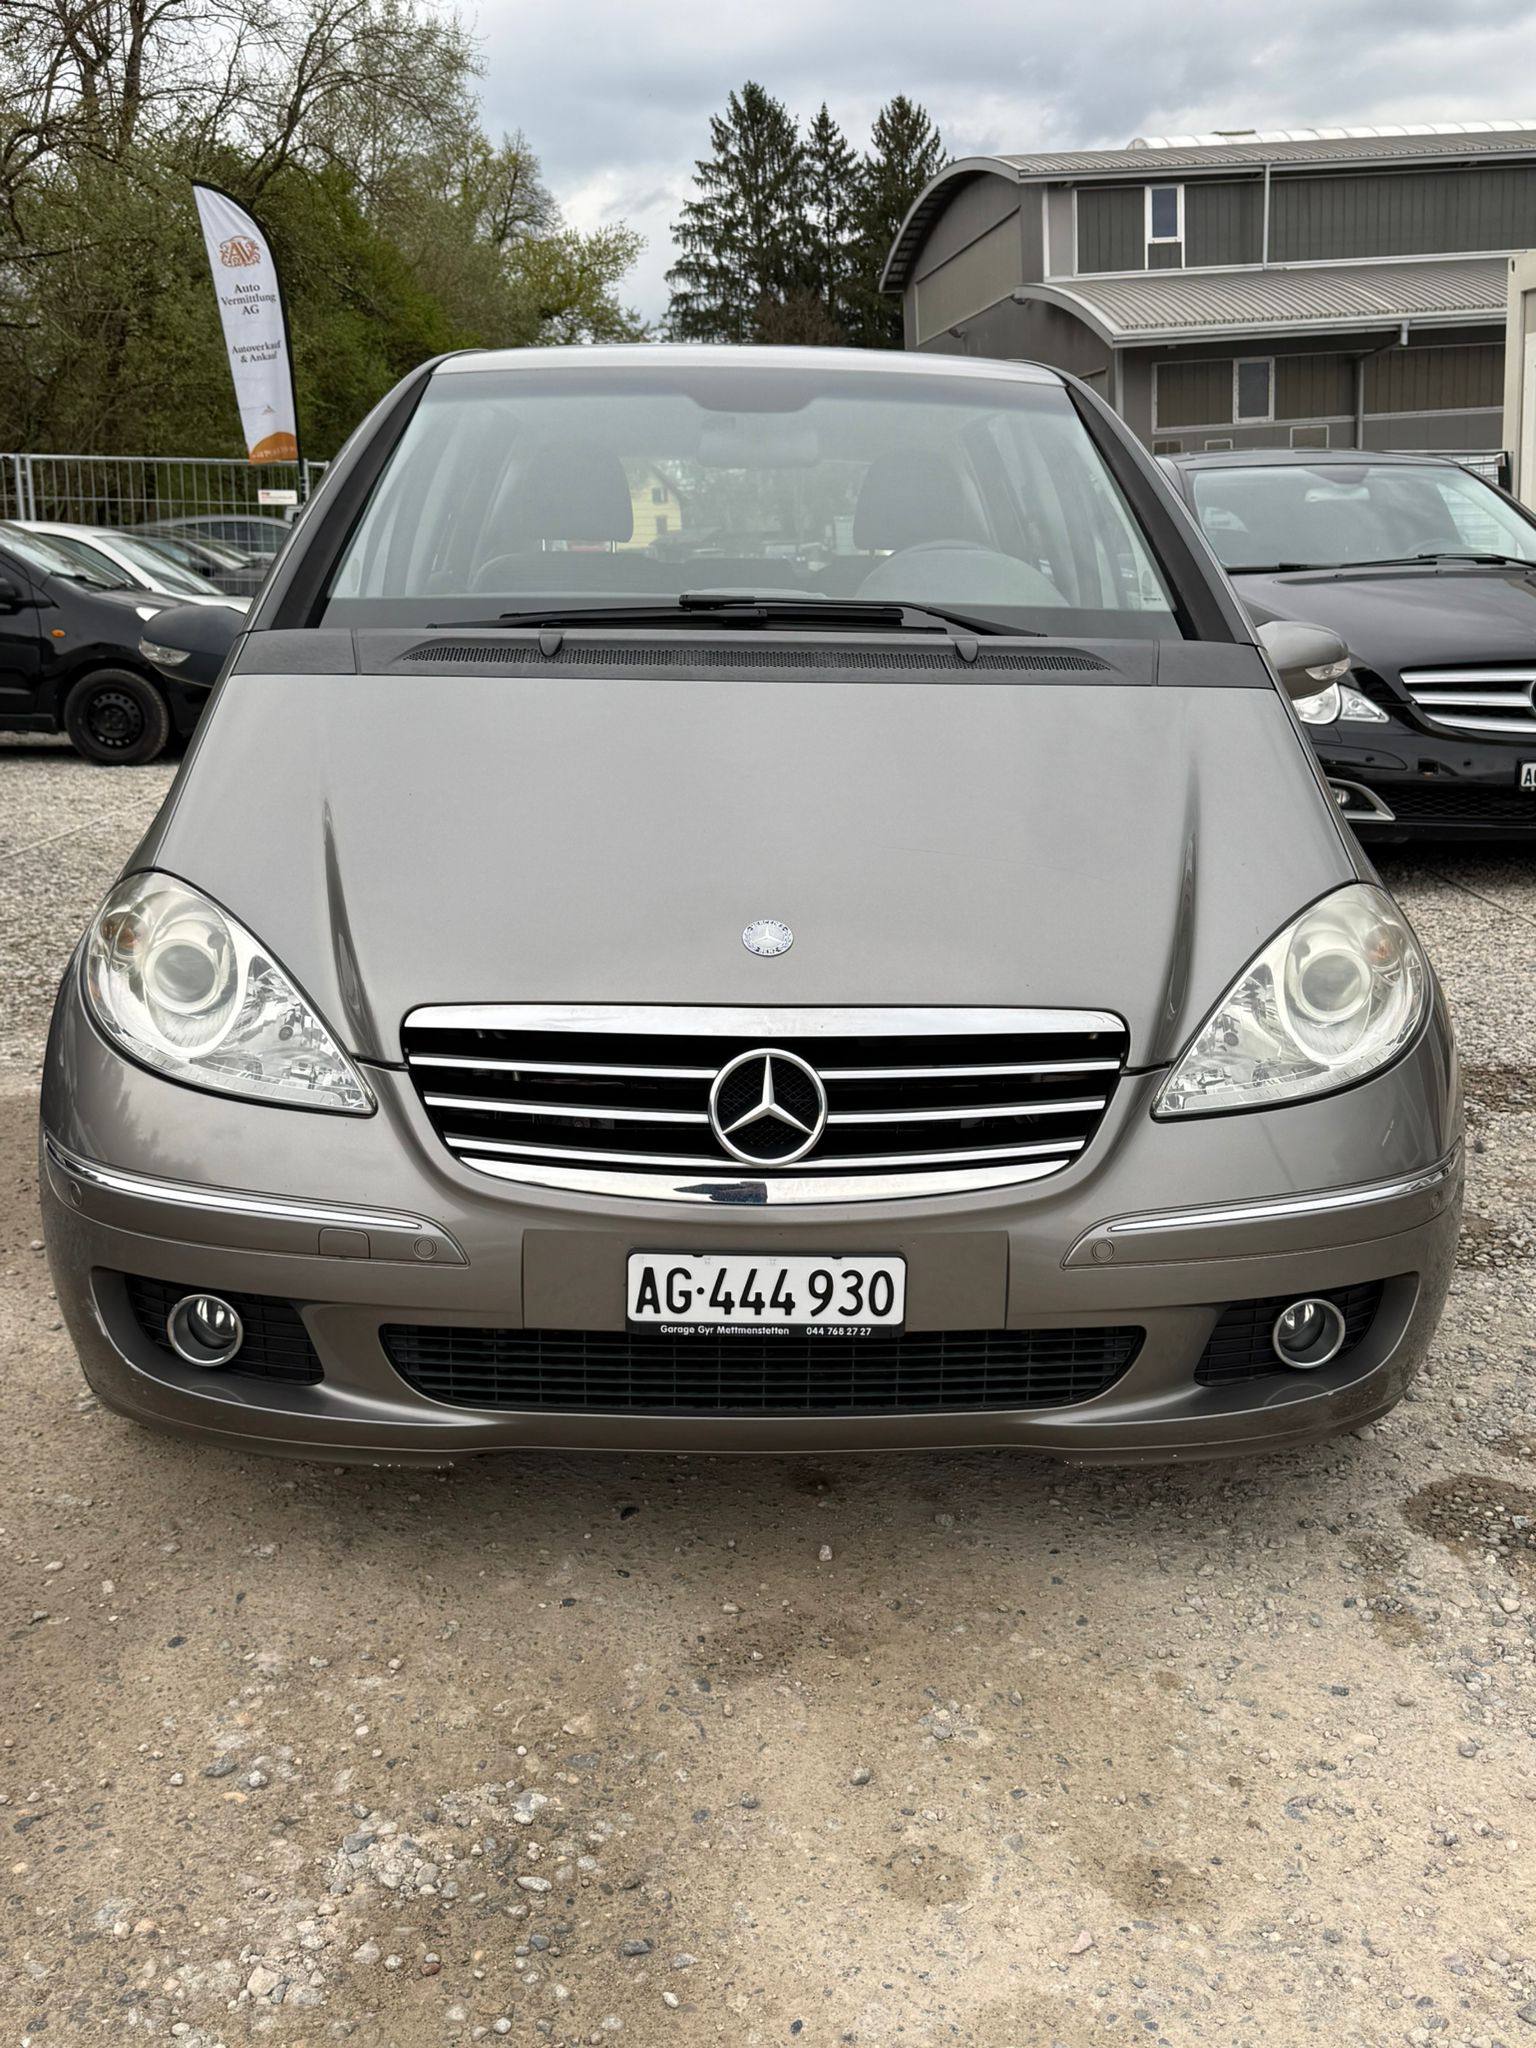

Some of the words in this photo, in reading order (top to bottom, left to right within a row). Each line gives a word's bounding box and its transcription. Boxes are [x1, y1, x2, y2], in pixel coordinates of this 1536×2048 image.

[234, 284, 261, 294] Auto
[221, 293, 276, 306] Vermittlung
[243, 304, 260, 315] AG
[232, 340, 281, 354] Autoverkauf
[240, 354, 248, 363] &
[250, 351, 277, 362] Ankauf
[660, 1325, 695, 1336] Garage
[698, 1325, 714, 1336] Gyr
[806, 1327, 824, 1335] 044
[827, 1327, 844, 1336] 768
[846, 1327, 858, 1336] 27
[860, 1327, 872, 1336] 27
